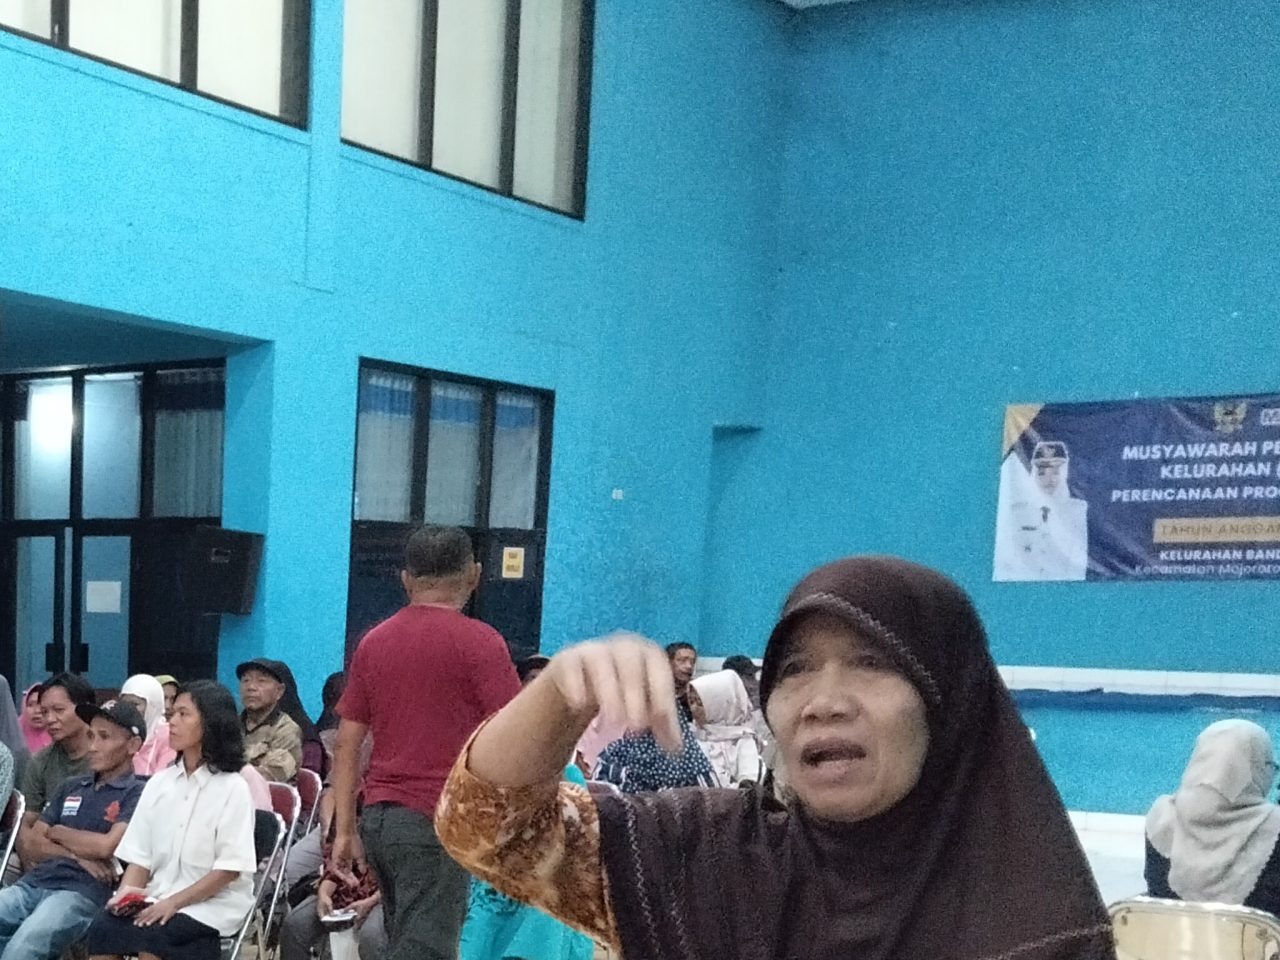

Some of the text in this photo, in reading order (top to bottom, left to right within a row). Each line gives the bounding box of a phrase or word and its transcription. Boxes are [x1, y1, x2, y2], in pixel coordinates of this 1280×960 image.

[1122, 441, 1257, 460] MUSYAWARAH
[1160, 461, 1271, 479] KELURAHAN
[1111, 486, 1238, 502] PERENCANAAN
[1161, 524, 1212, 537] TAHUN
[1160, 549, 1243, 561] KELURAHAN
